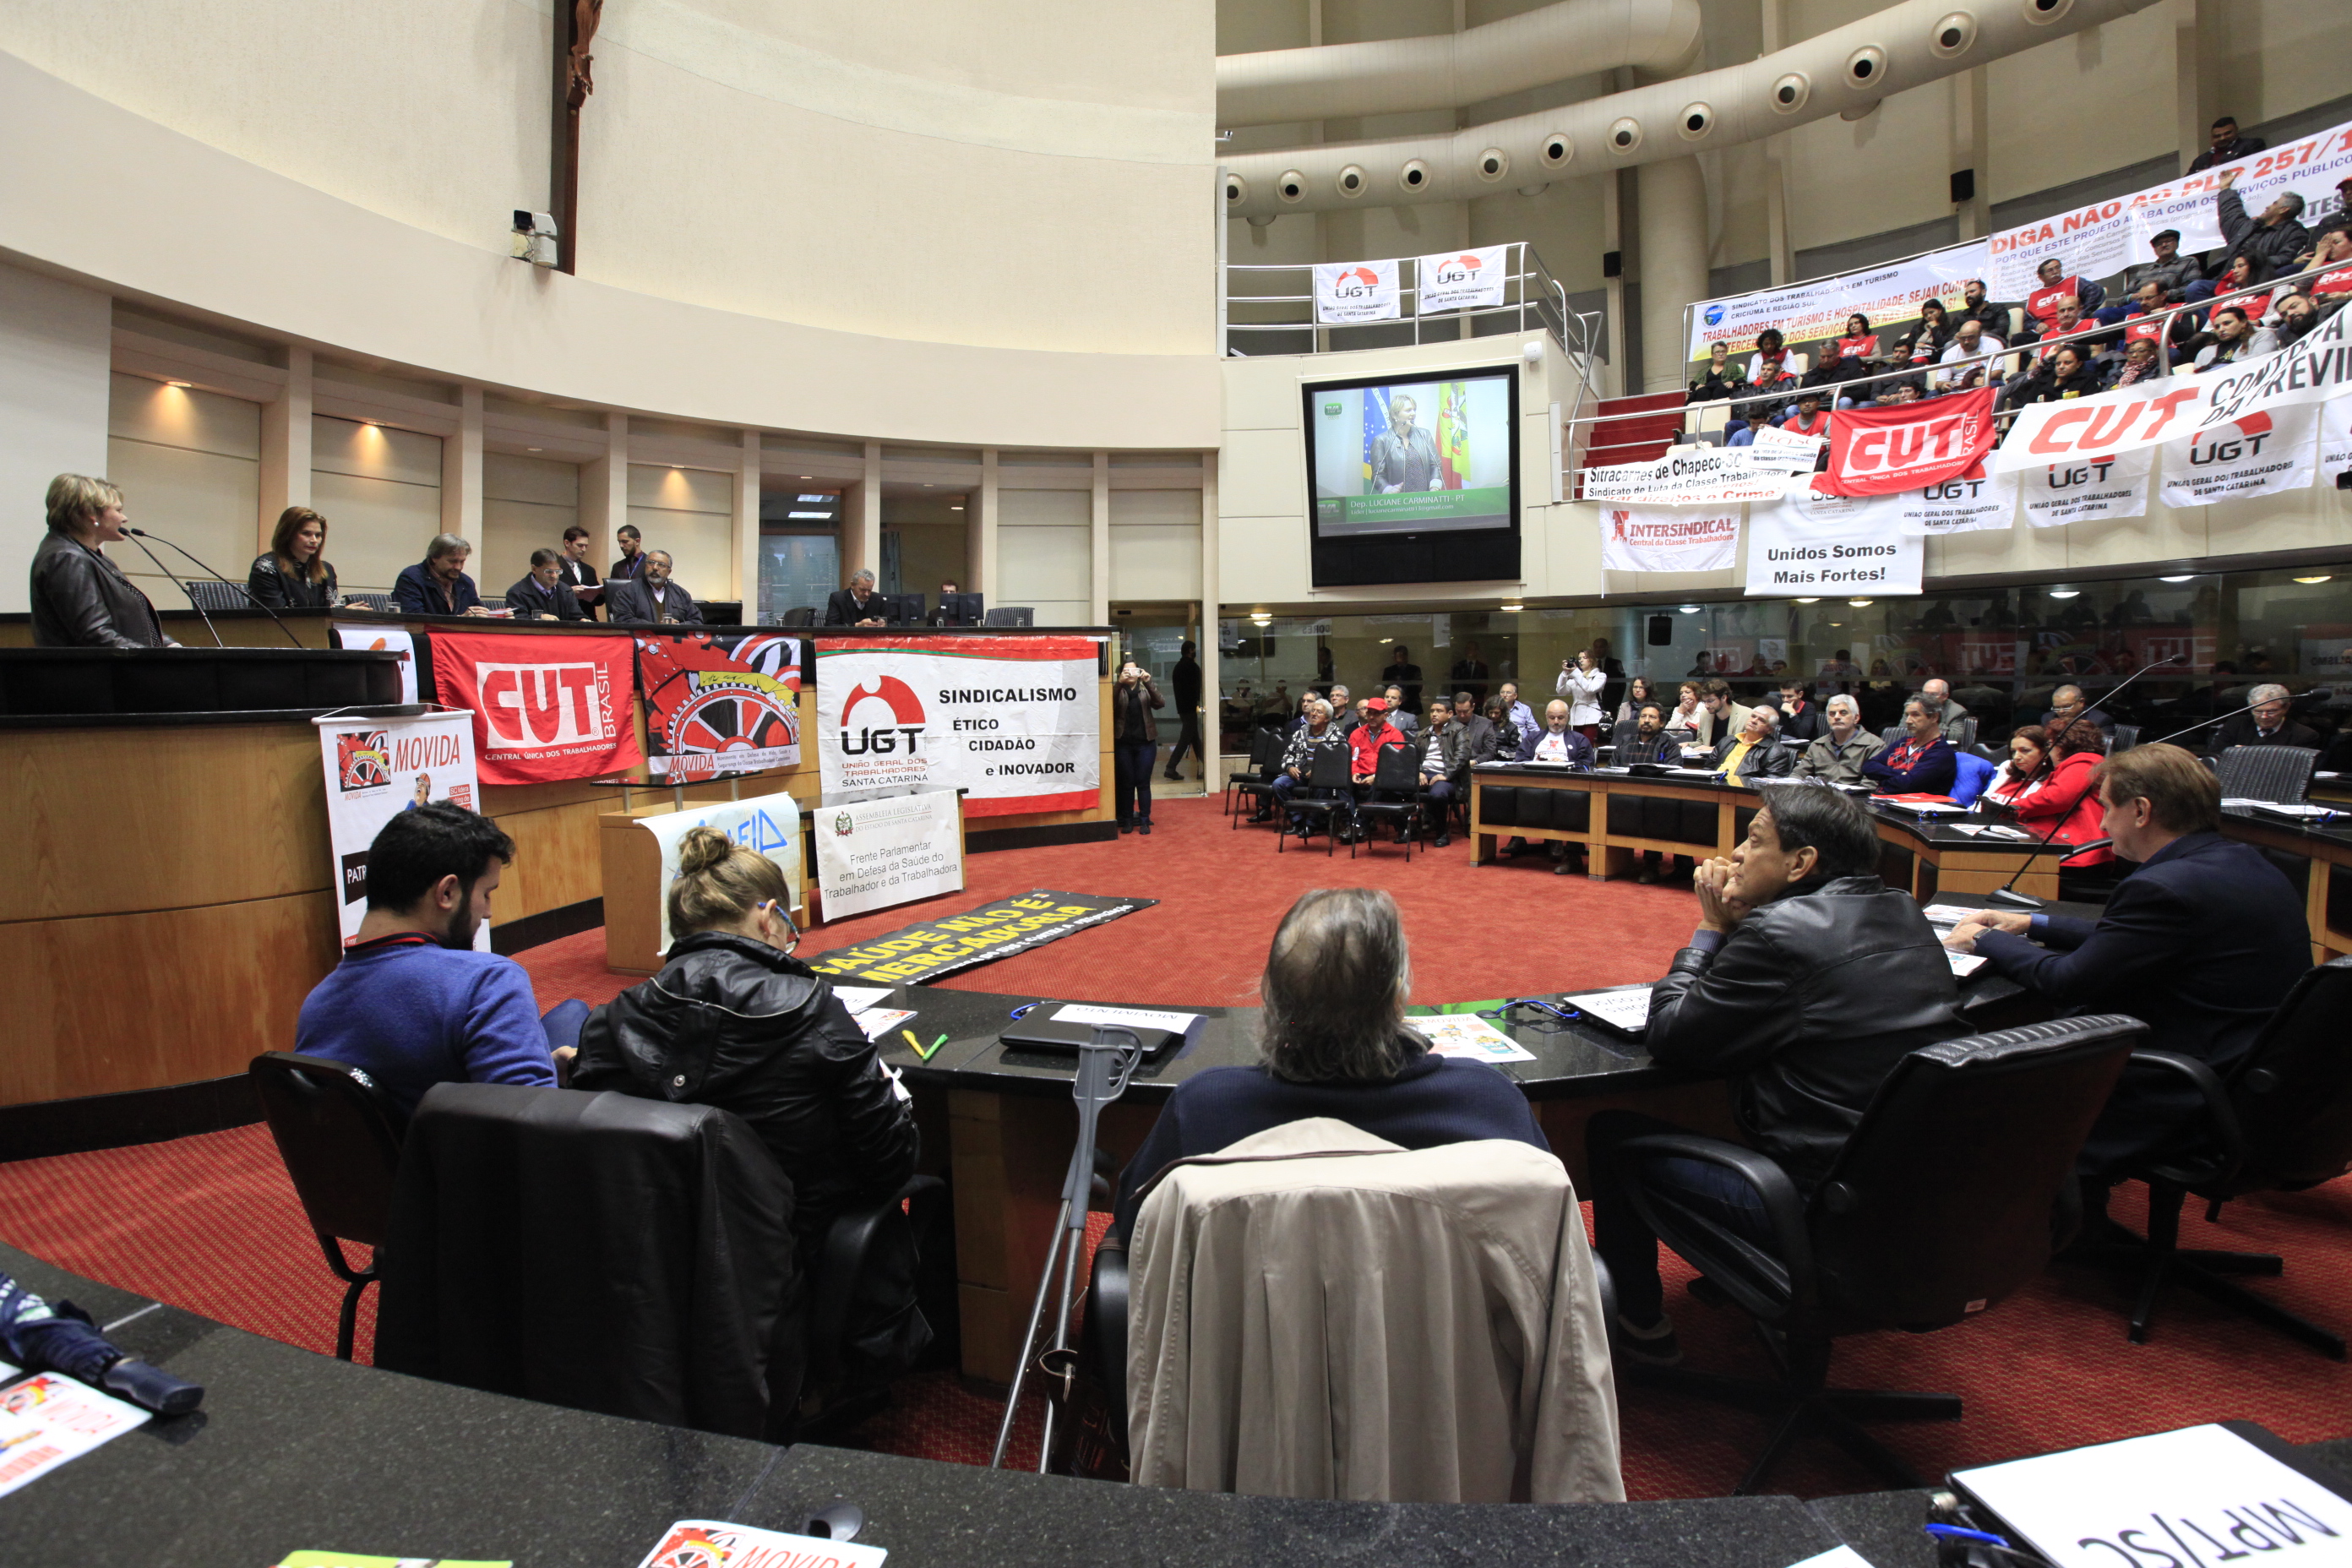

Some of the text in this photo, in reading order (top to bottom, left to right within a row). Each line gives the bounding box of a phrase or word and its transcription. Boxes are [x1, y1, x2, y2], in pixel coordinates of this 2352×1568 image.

[1991, 223, 2055, 254] DIGA
[2062, 201, 2121, 234] NÃO
[2127, 188, 2172, 210] AO
[1995, 253, 2017, 264] POR
[2020, 247, 2041, 259] QUE
[2044, 237, 2070, 252] ESTE
[2073, 218, 2120, 242] PROJETO
[2123, 205, 2164, 224] ACABA
[2168, 199, 2197, 214] COM
[2201, 194, 2218, 206] OS
[1437, 269, 1482, 285] UGT
[1335, 285, 1379, 299] UGT
[1732, 270, 1899, 310] SINDICATO DOS TRABALHADORES EM TURISMO
[2037, 291, 2065, 307] CUT
[1702, 284, 1939, 343] TRABALHADORES EM TURISMO E HOSPITALIDADE, SEJAM
[1731, 308, 1764, 319] CRICIÚMA
[1772, 302, 1799, 313] REGIÃO
[1788, 318, 1848, 342] DOS SERVIÇOS
[2028, 386, 2200, 455] CUT
[2199, 396, 2245, 427] DA
[1849, 409, 1979, 471] CUT RASIL
[2190, 433, 2272, 466] UGT
[1590, 466, 1653, 482] Sitracarnes
[1655, 464, 1669, 480] de
[1840, 476, 1867, 485] CENTRAL
[1911, 460, 1966, 475] TRABALHADORE
[2049, 462, 2115, 488] UGT
[2167, 460, 2294, 488] UNIÃO GERAL DOS TRABALHADORES
[1589, 487, 1631, 497] Sindicato
[1634, 486, 1645, 494] de
[1672, 482, 1682, 490] da
[1686, 478, 1718, 487] Classe
[1720, 470, 1787, 483] Trabalhadora
[1924, 480, 1985, 500] UGT
[2194, 478, 2266, 497] DE SANTA CATARINA
[1369, 498, 1402, 507] LUCIANE
[1403, 495, 1450, 505] CARMINATTI
[2029, 490, 2132, 509] UNIÃO GERAL DOS TRABALHADORES
[1903, 509, 1922, 518] UNIÃO
[1924, 509, 1941, 517] GERAL
[1954, 504, 1999, 516] TRABALHADORES
[2052, 503, 2108, 517] DE SANTA CATARINA
[1630, 518, 1734, 537] INTERSINDICAL
[1630, 533, 1734, 546] Central da Classe Trabalhadora
[1767, 544, 1897, 561] Unidos Somos
[1773, 567, 1886, 584] Mais Fortes!
[482, 662, 617, 743] CUT BRASIL
[939, 687, 1077, 704] SINDICALISMO
[953, 717, 999, 731] ÉTICO
[841, 727, 926, 756] UGT
[968, 738, 1036, 751] CIDADÃO
[395, 733, 460, 772] MOVIDA
[485, 743, 617, 761] CENTRAL ÚNICA DOS TRABALHADORES
[668, 754, 714, 772] MOVIDA
[842, 757, 928, 769] UNIÃO GERAL DOS
[845, 765, 926, 776] TRABALHADORES
[986, 762, 1075, 776] e INOVADOR
[841, 774, 928, 787] SANTA CATARINA
[345, 791, 362, 802] MOVIDA
[855, 803, 932, 821] ASSEMBLEIA LEGISLATIVA
[864, 822, 884, 830] ESTADO
[891, 819, 908, 827] SANTA
[909, 814, 933, 825] CATARINA
[850, 840, 932, 866] Frente Parlamentar
[839, 852, 944, 882] em Defesa da Saúde do
[824, 862, 957, 900] Trabalhador e da Trabalhadora
[810, 898, 1055, 975] SAÚDE NÃO É
[859, 906, 1096, 982] MERCADORIA
[995, 943, 1021, 953] SUS
[1025, 927, 1065, 942] CONTRA
[1077, 1007, 1178, 1020] MOVIMENTO
[2077, 1498, 2341, 1568] MPT/SC
